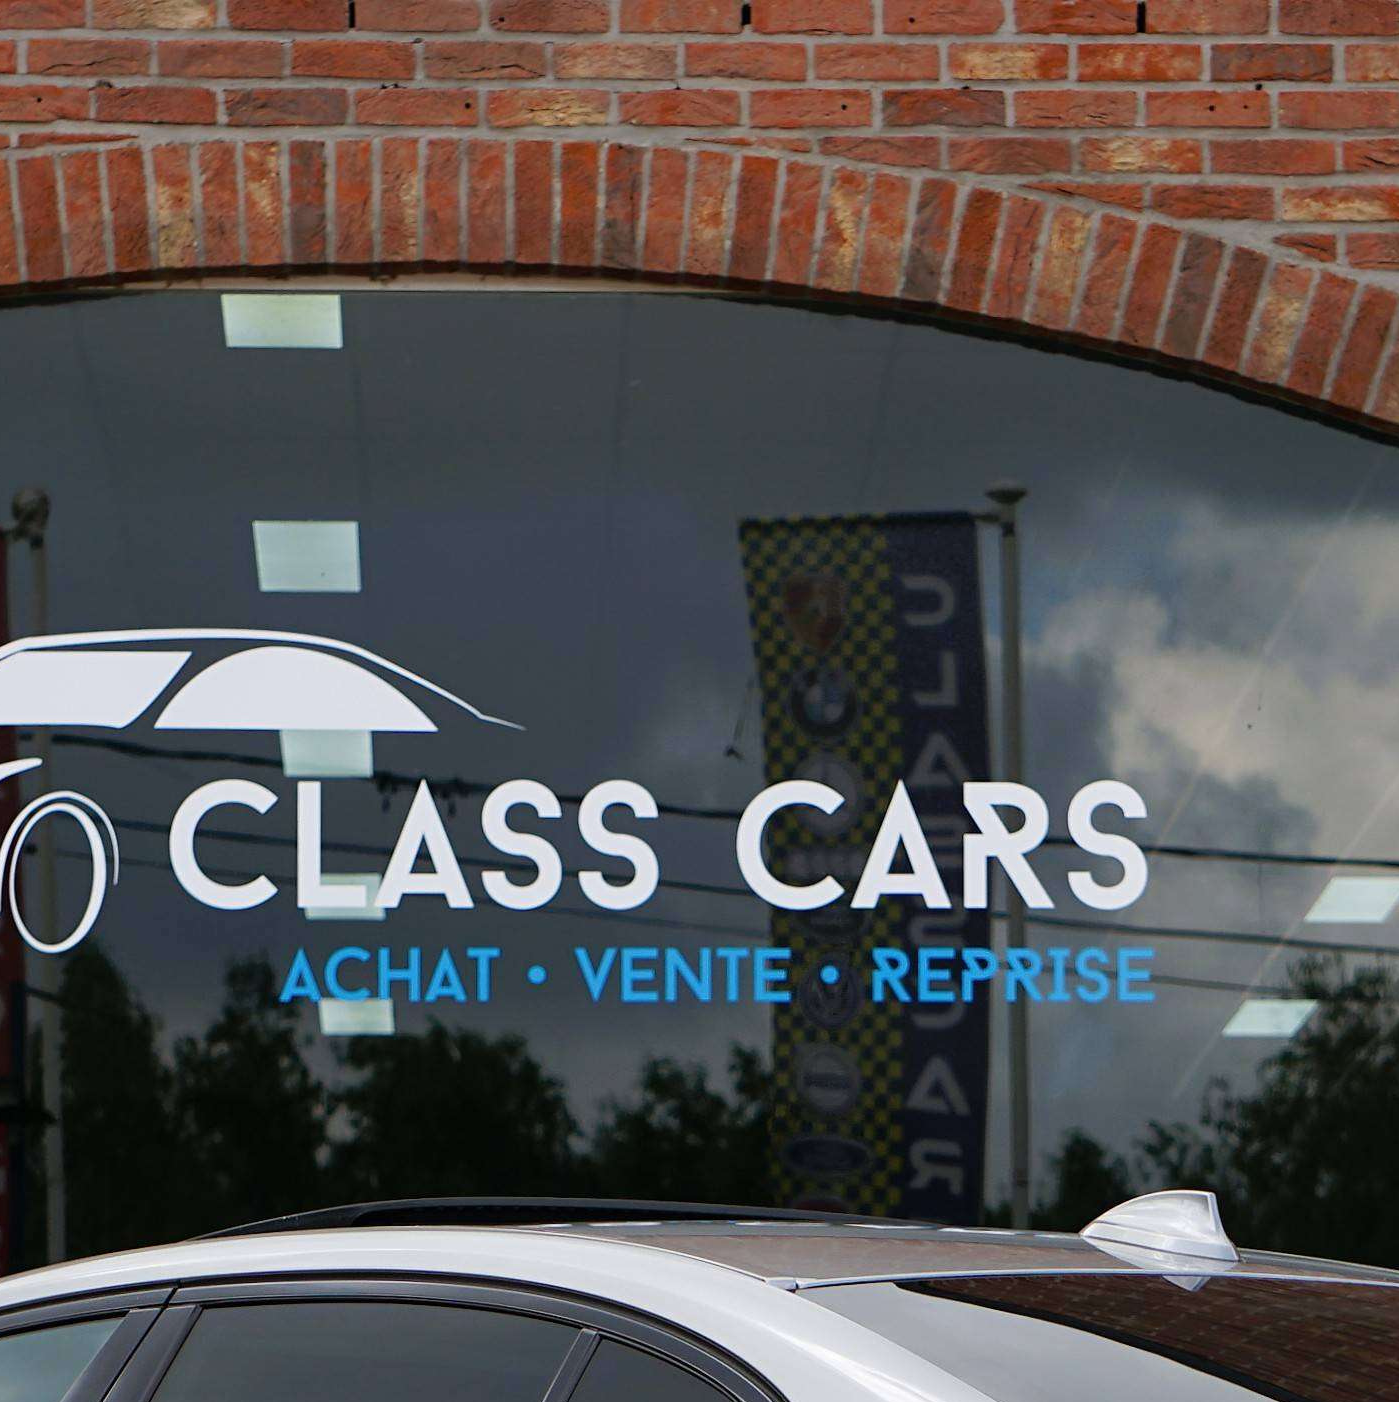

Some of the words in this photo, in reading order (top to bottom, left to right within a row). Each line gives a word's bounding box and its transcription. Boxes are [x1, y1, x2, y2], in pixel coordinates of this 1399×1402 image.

[168, 778, 660, 910] CLASS
[735, 779, 1149, 910] CARS
[279, 946, 502, 1003] ACHAT
[573, 946, 792, 1003] VENTE
[871, 946, 1156, 1003] REPRISE
